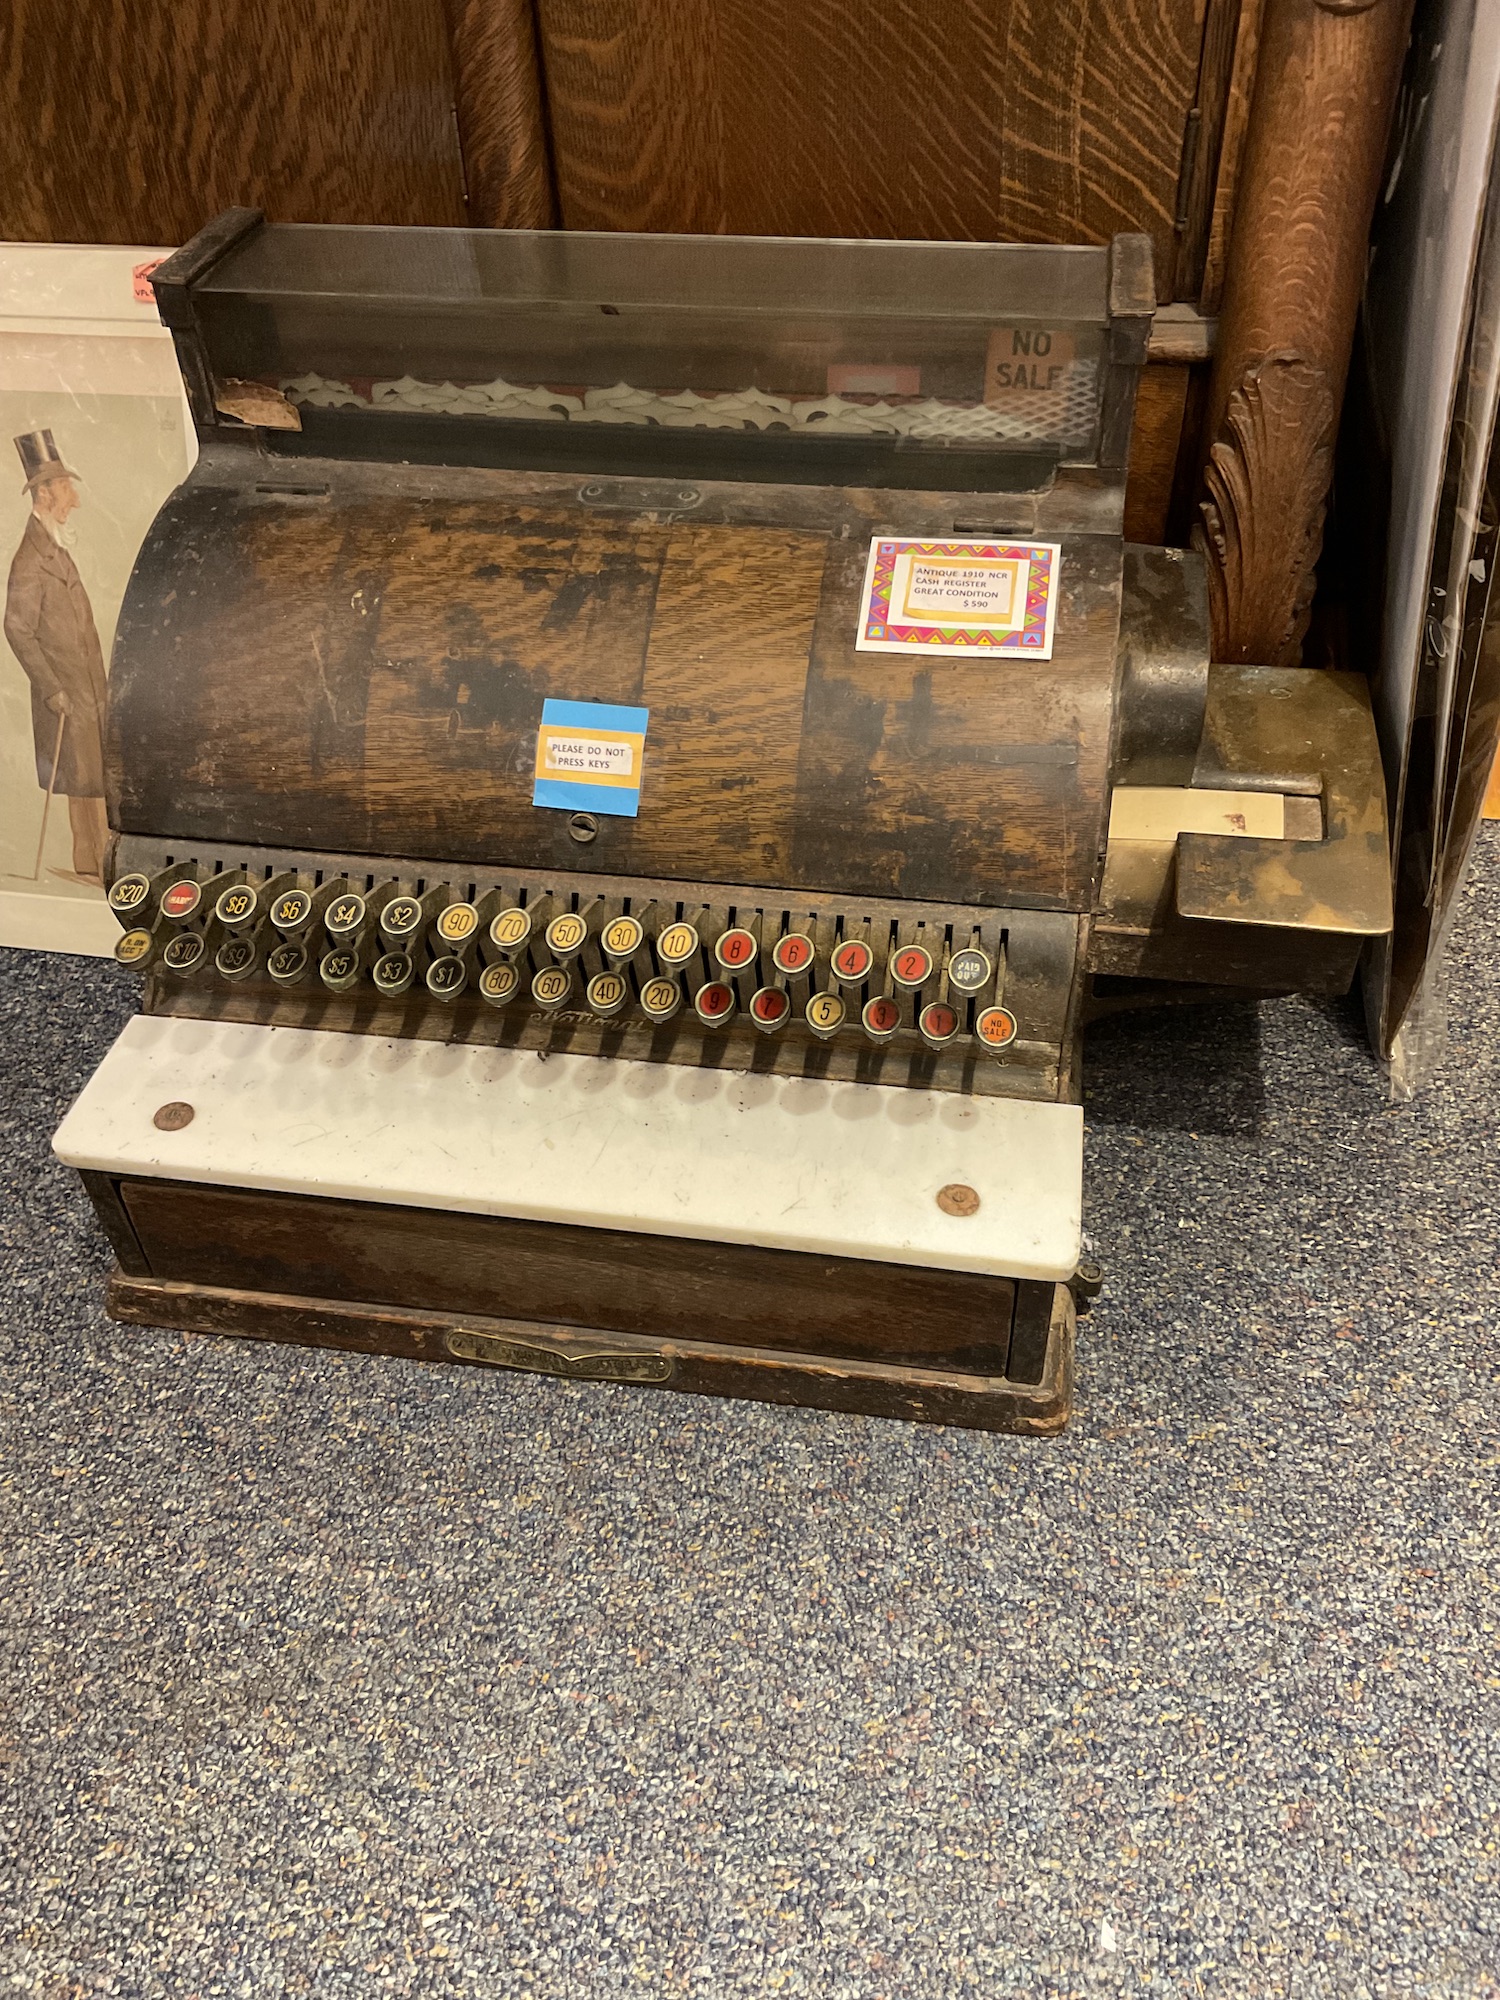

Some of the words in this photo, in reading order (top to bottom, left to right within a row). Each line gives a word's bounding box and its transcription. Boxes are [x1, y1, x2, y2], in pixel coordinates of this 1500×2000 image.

[1011, 329, 1053, 358] NO
[995, 363, 1064, 391] SALE
[916, 567, 958, 577] ANTIQUE
[963, 570, 984, 578] 1910
[915, 577, 939, 585] CASH
[944, 579, 987, 588] REGISTER
[914, 587, 944, 596] GREAT
[946, 588, 999, 598] CONDITION
[971, 600, 988, 608] 590
[552, 743, 583, 754] PLEASE
[587, 746, 602, 755] DO
[605, 748, 626, 757] NOT
[558, 757, 584, 767] PRESS
[588, 760, 610, 769] KEYS
[115, 884, 144, 903] $20
[225, 895, 249, 915] $8
[279, 900, 302, 920] $6
[333, 904, 357, 924] $4
[390, 906, 413, 926] $2
[448, 913, 470, 931] 90
[501, 918, 523, 938] 70
[556, 924, 578, 943] 50
[611, 928, 632, 947] 30
[170, 942, 198, 961] $10
[669, 934, 686, 953] 10
[730, 940, 742, 959] 8
[225, 947, 246, 966] $9
[276, 952, 298, 970] $7
[788, 944, 799, 963] 6
[845, 951, 856, 970] 4
[328, 957, 350, 975] $5
[382, 962, 403, 980] $3
[435, 966, 455, 984] $1
[905, 956, 916, 976] 2
[956, 971, 977, 980] OUT
[957, 962, 981, 972] PAID
[488, 971, 510, 990] 80
[541, 977, 561, 995] 60
[596, 982, 616, 1000] 40
[650, 987, 670, 1006] 20
[709, 991, 720, 1010] 9
[763, 997, 773, 1015] 7
[820, 1002, 832, 1020] 5
[876, 1006, 886, 1025] 3
[984, 1027, 1008, 1037] SALE
[990, 1019, 1003, 1028] NO
